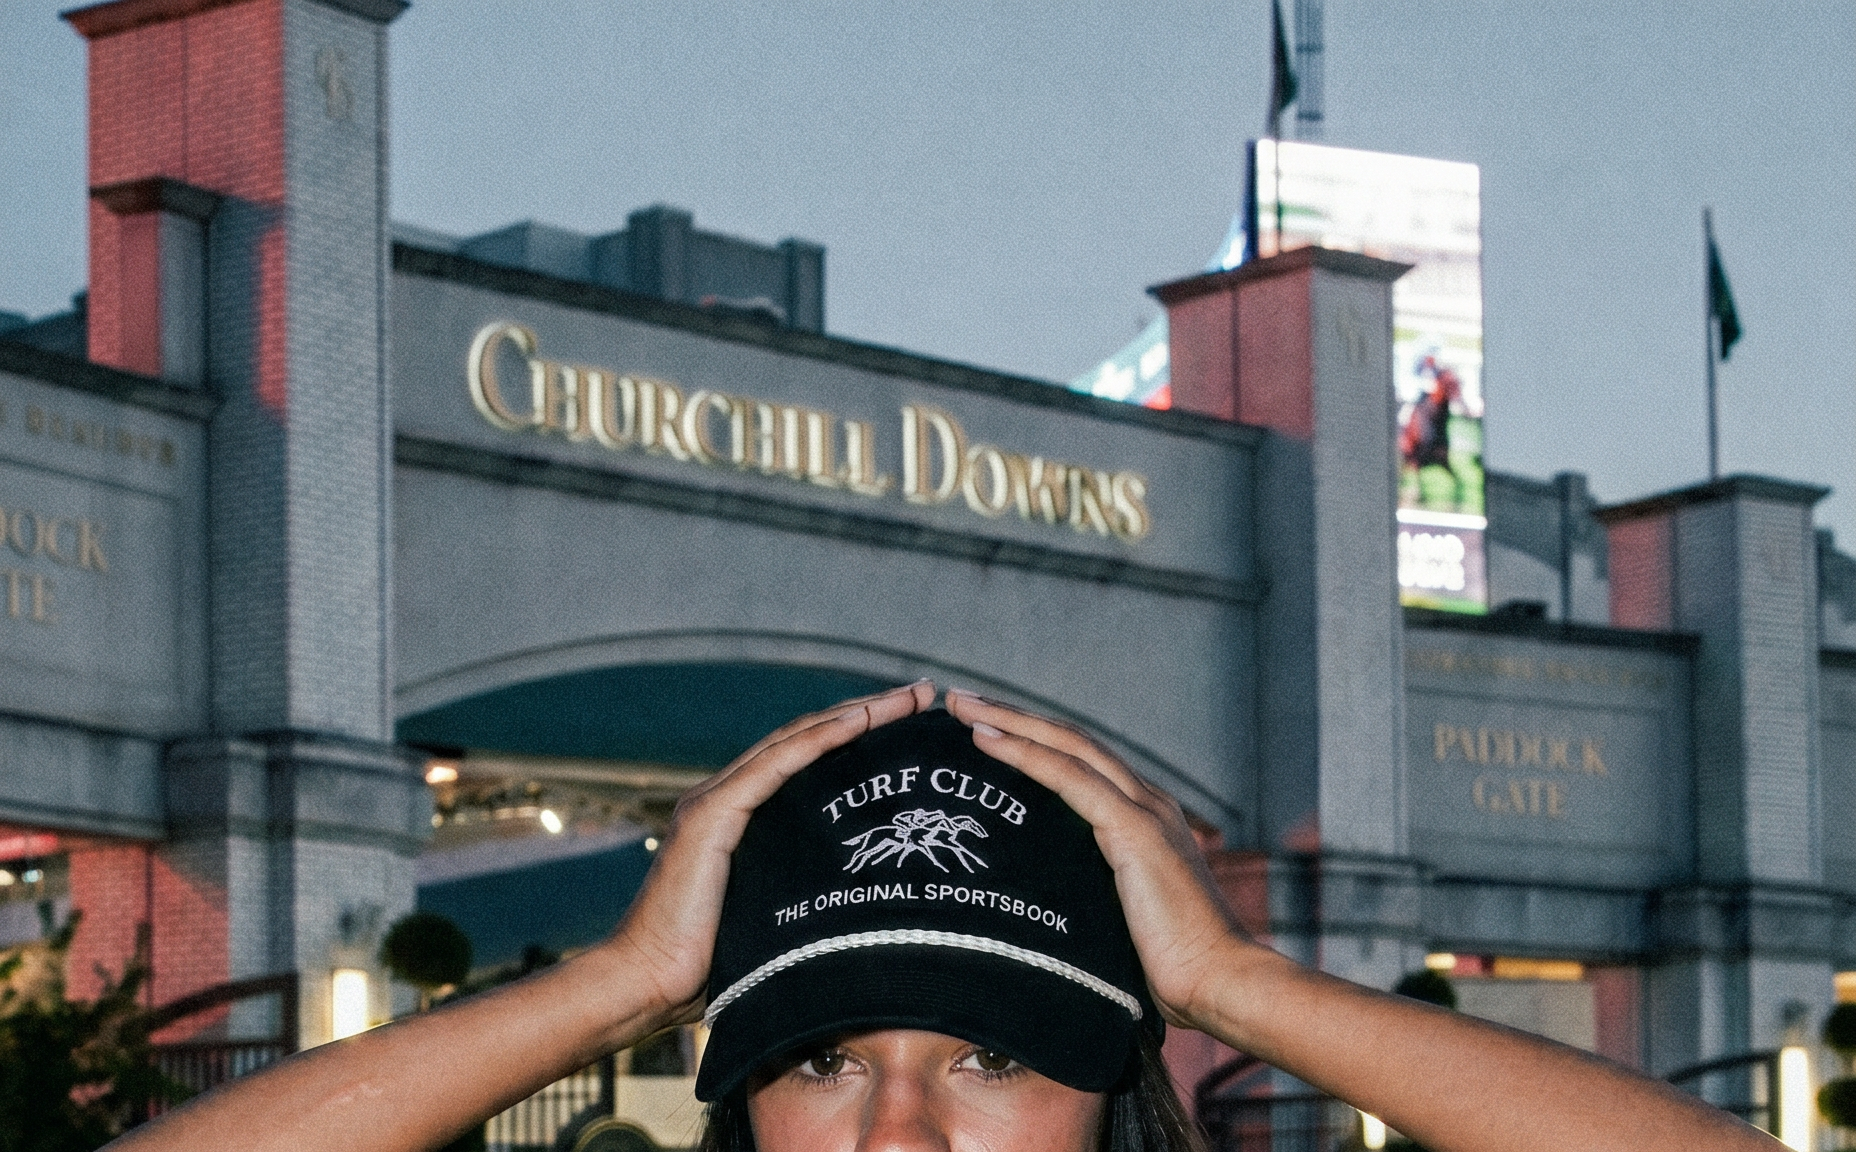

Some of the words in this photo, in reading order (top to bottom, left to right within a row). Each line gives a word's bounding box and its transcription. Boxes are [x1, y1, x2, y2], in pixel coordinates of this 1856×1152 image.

[467, 321, 892, 496] CHURCHILL
[901, 403, 1150, 541] DOWNS
[0, 508, 108, 573] OCK
[822, 766, 920, 824] TURF
[930, 768, 1028, 826] CLUB
[775, 901, 809, 926] THE
[815, 883, 919, 911] ORIGINAL
[924, 883, 1068, 934] SPORTSBOOK
